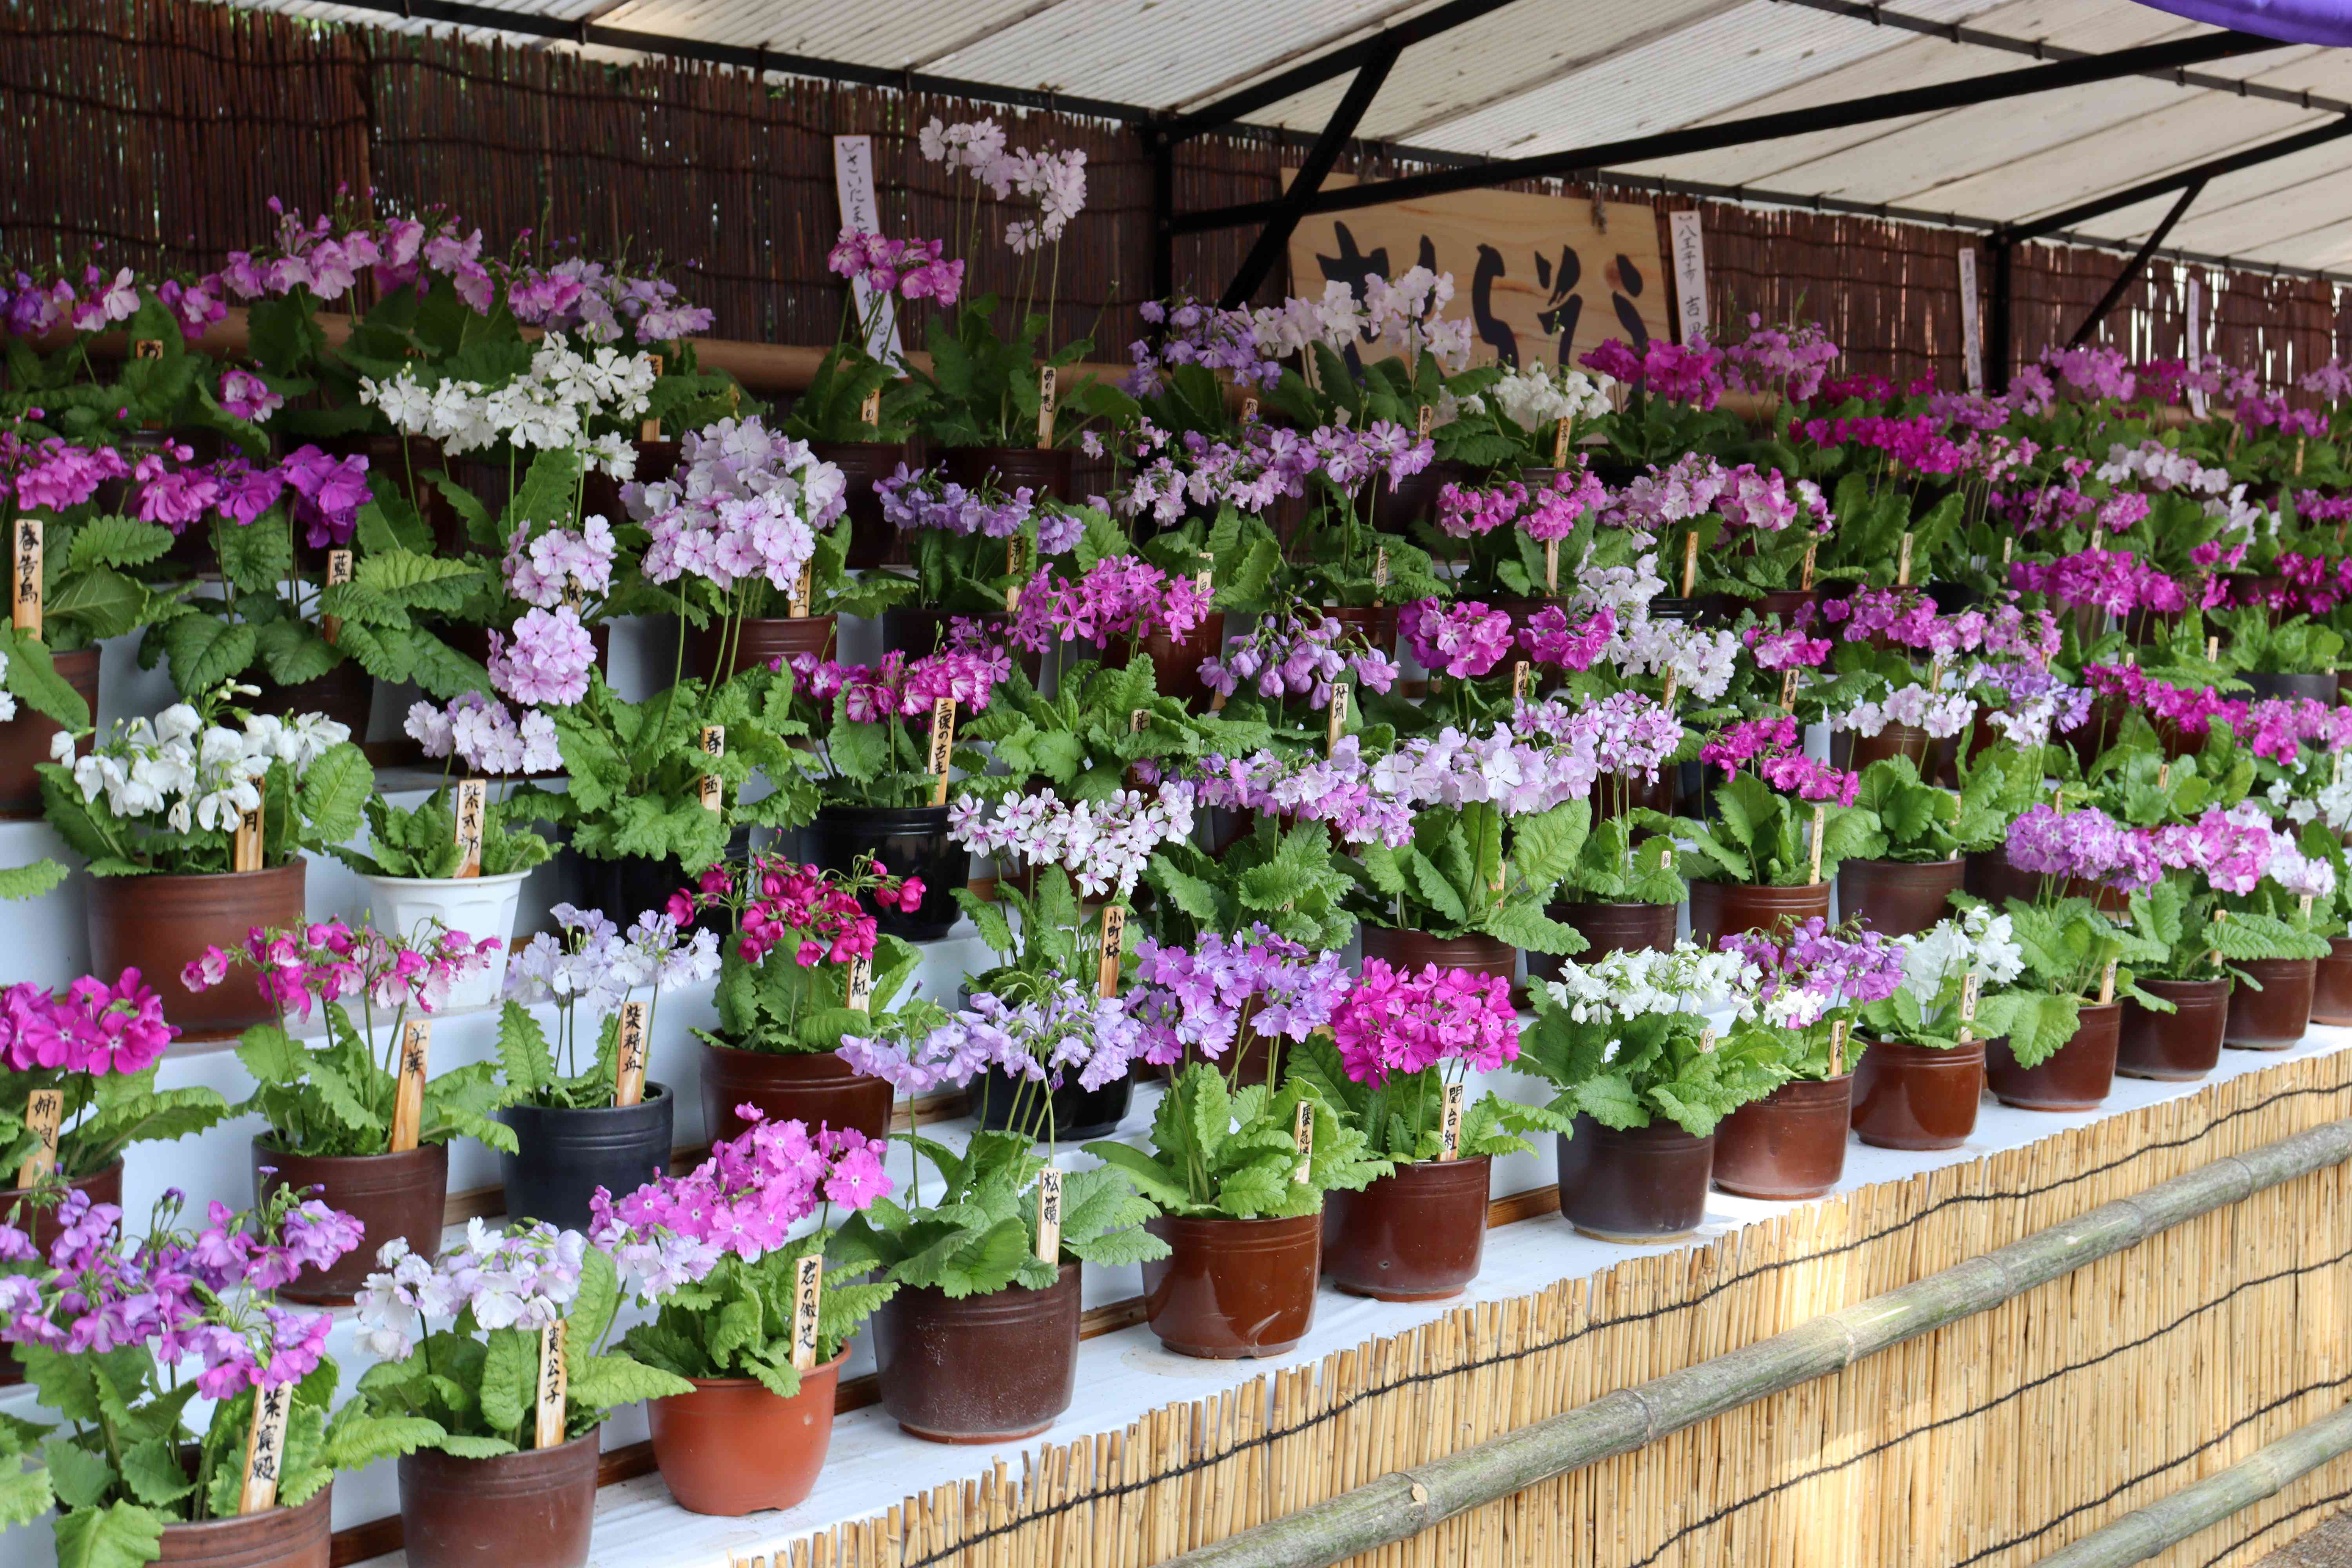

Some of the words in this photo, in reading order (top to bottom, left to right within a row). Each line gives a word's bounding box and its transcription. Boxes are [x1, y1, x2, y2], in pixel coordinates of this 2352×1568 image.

[1679, 225, 1697, 285] 八王子市
[16, 521, 39, 605] 春告鳥
[798, 1259, 817, 1349] 君の微笑
